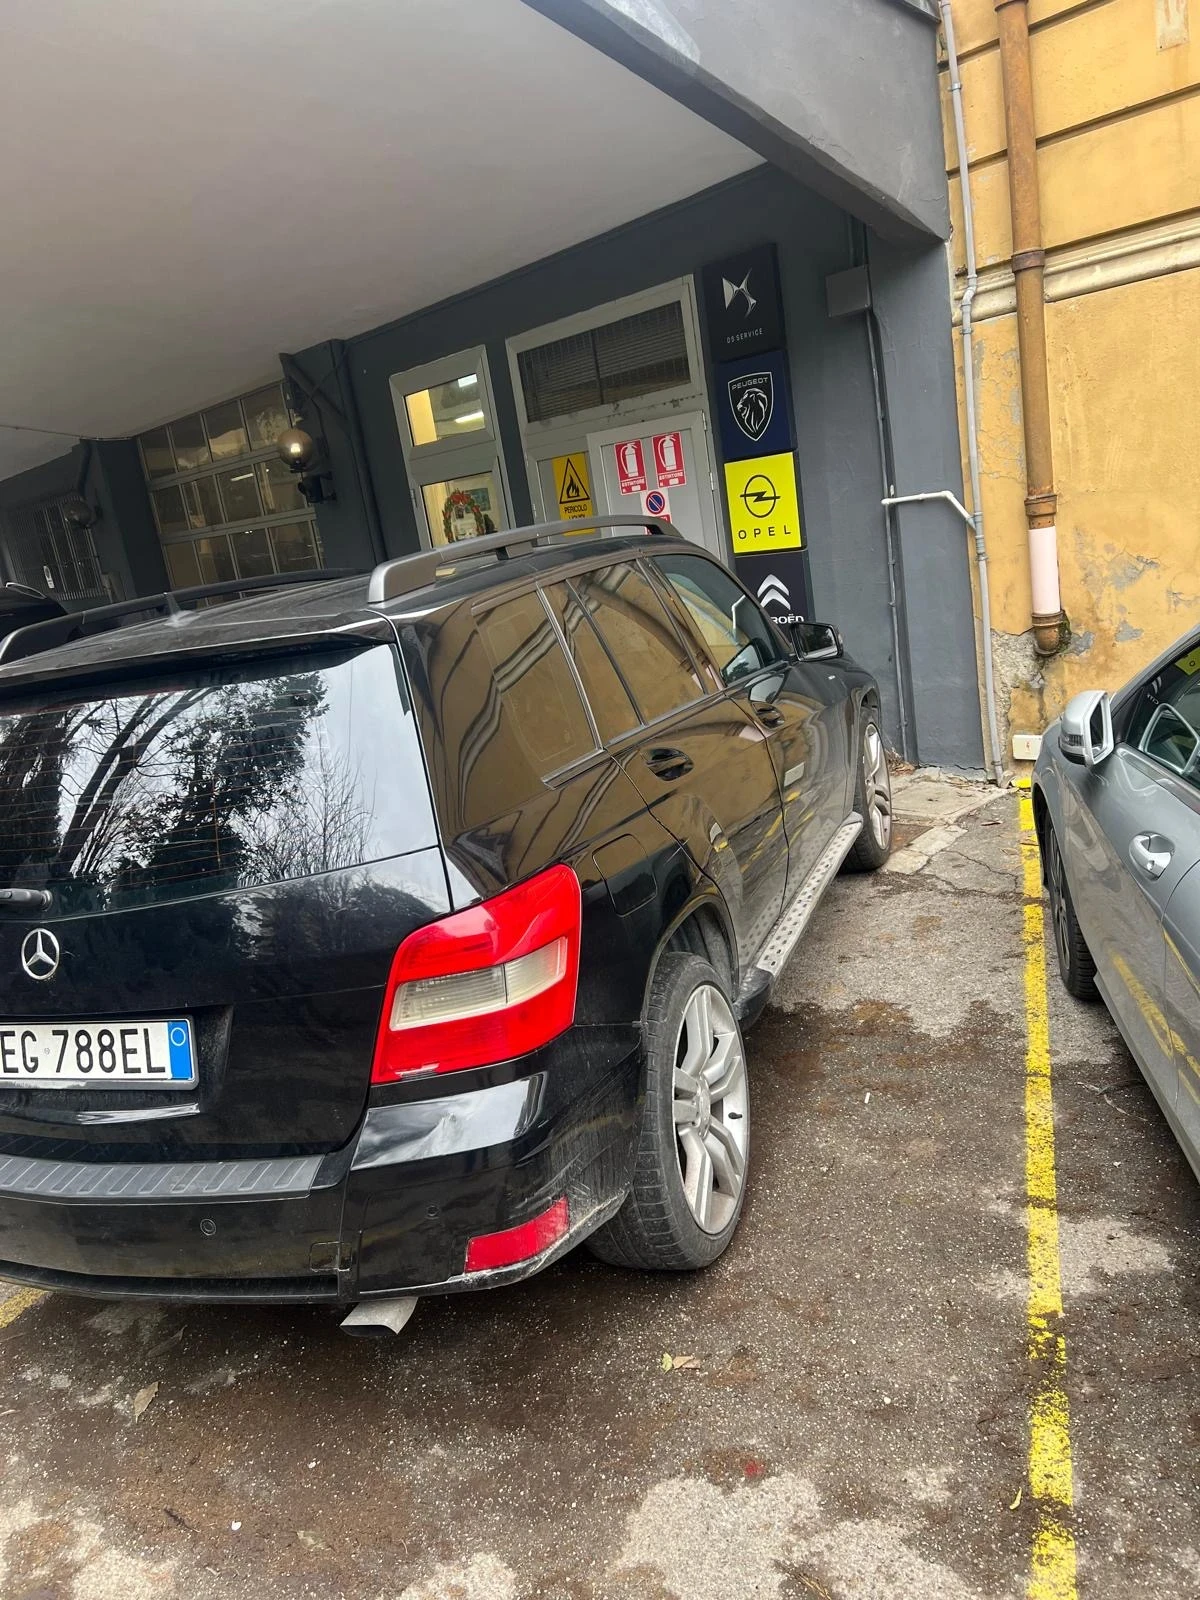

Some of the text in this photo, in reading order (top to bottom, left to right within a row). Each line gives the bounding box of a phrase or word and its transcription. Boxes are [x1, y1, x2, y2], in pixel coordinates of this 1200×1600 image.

[736, 327, 763, 341] SERVICE
[731, 376, 768, 390] PEUGEOT
[564, 503, 588, 514] PERICOLO
[738, 524, 792, 540] OPEL
[770, 613, 805, 624] ROËN
[0, 1027, 166, 1074] EG 788EL
